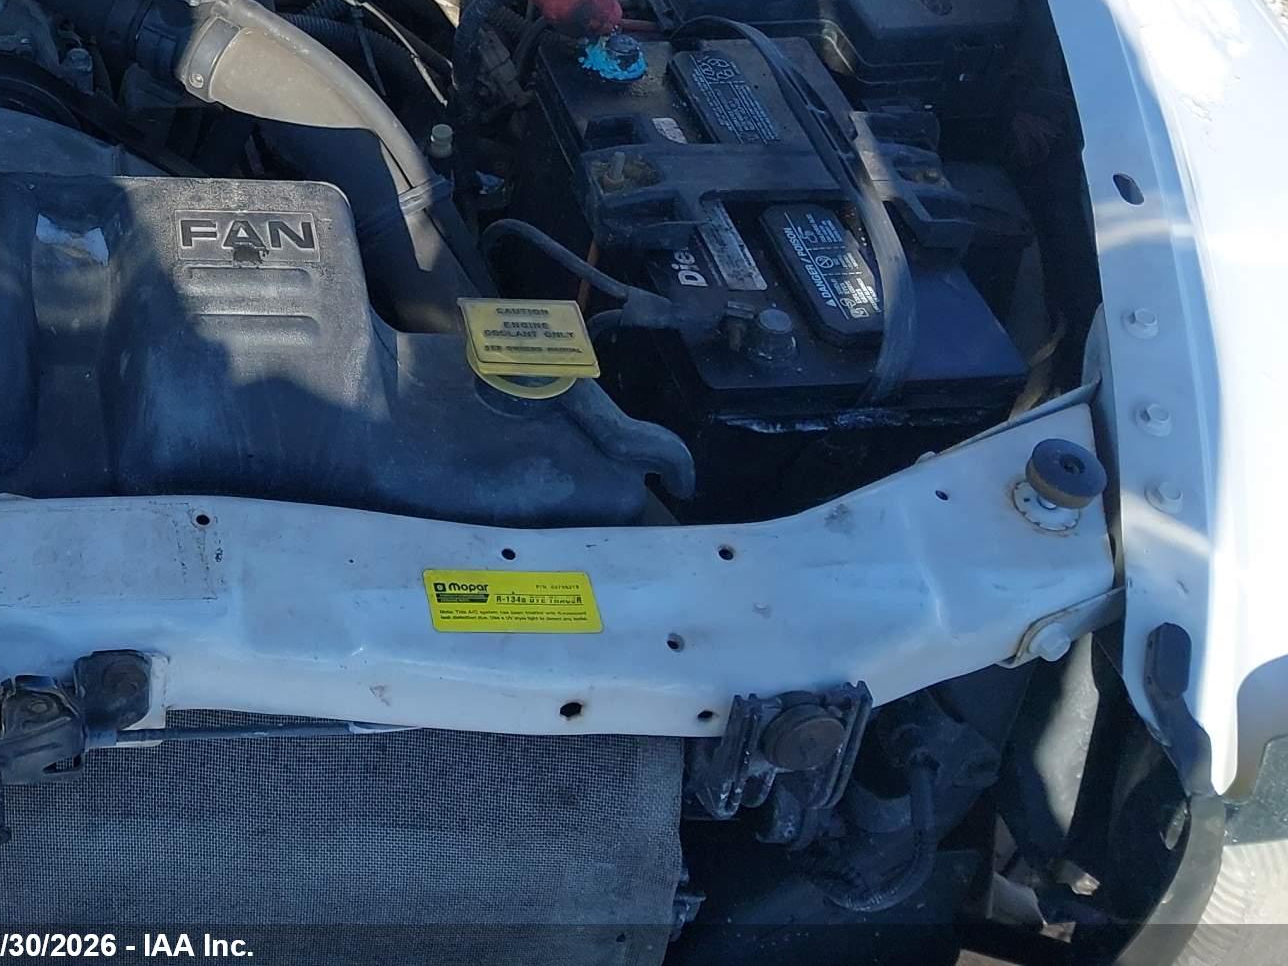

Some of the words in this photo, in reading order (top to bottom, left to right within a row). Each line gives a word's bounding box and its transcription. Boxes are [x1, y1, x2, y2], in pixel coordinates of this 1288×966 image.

[177, 216, 314, 251] FAN
[783, 227, 808, 258] POISON
[805, 264, 832, 299] DANGER
[496, 307, 549, 315] CAUTION
[484, 329, 538, 338] COOLANT
[503, 321, 549, 329] ENGINE
